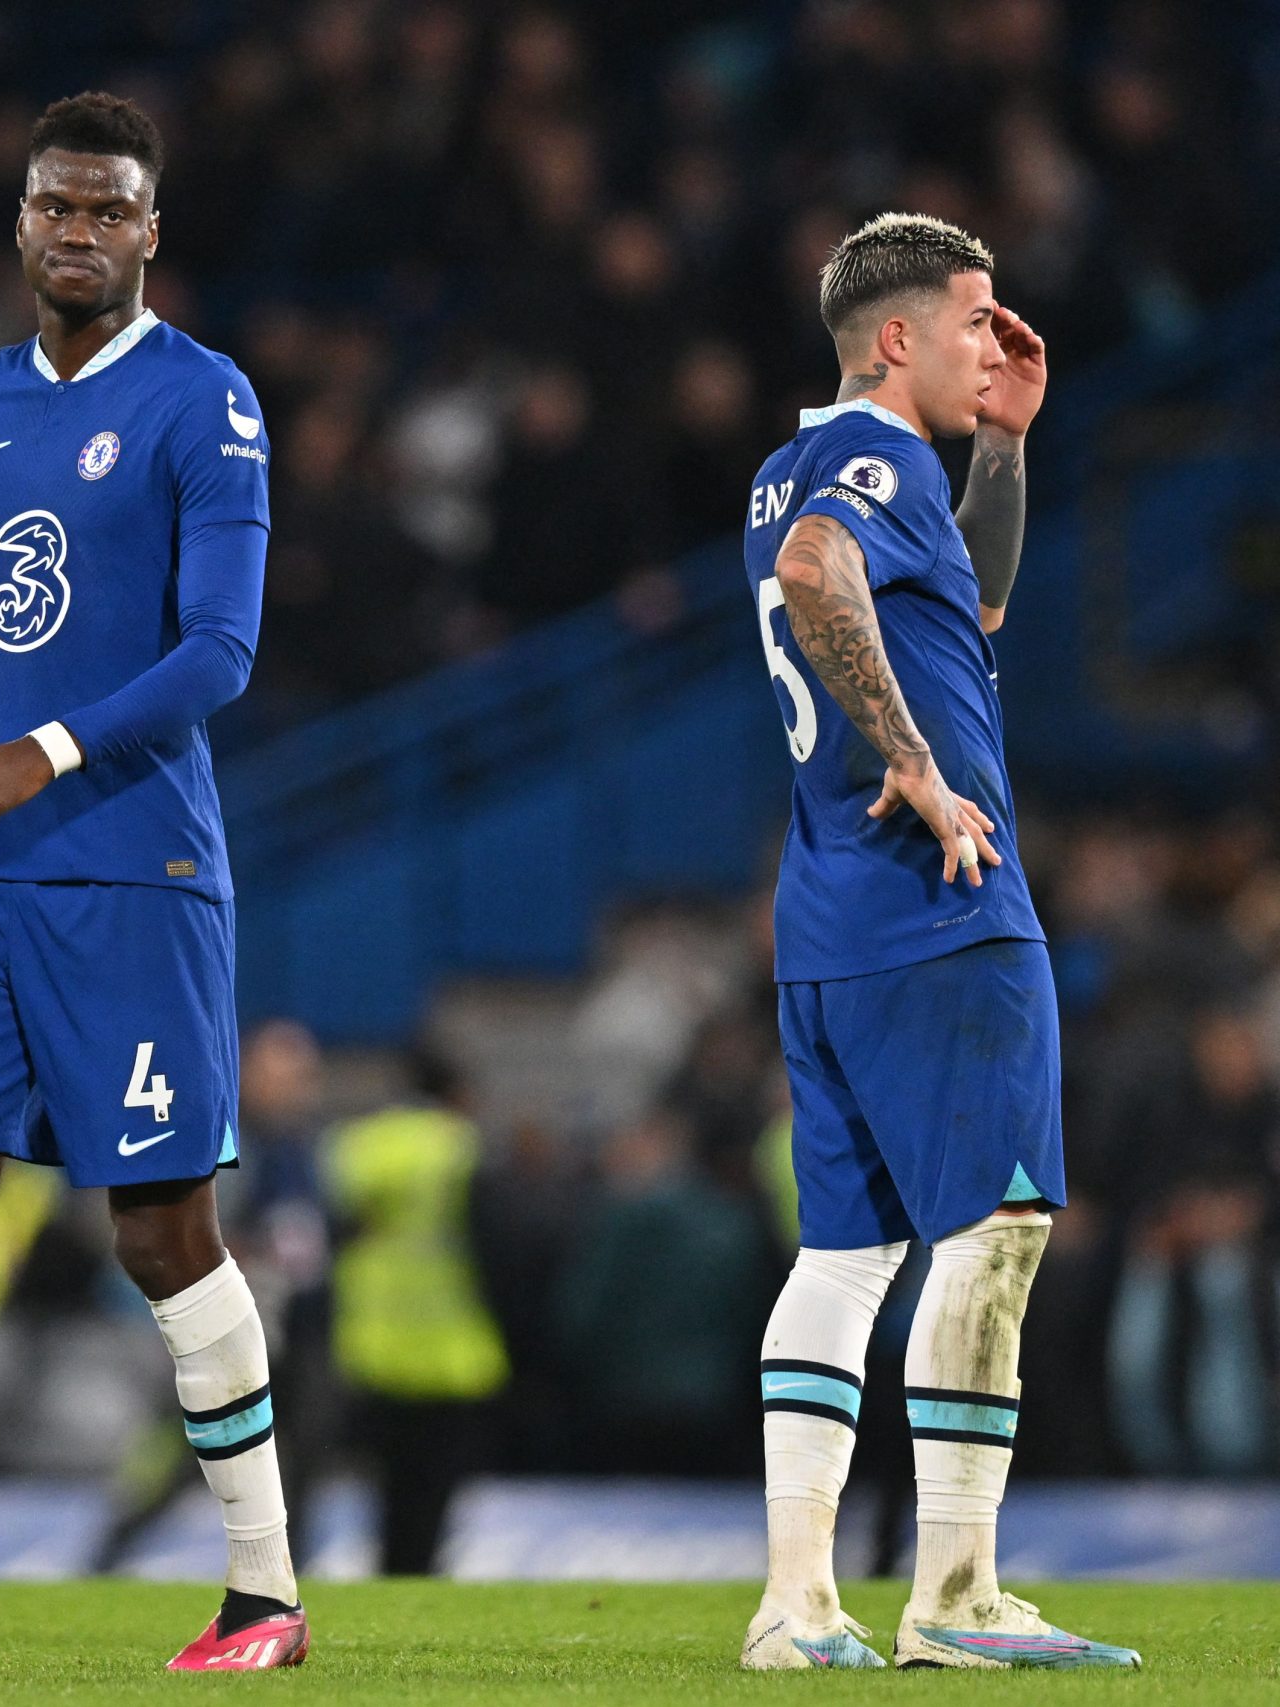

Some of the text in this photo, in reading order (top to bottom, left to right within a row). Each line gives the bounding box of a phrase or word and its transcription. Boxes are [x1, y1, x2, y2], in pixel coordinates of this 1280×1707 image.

[836, 487, 870, 511] room
[758, 575, 818, 764] 5
[123, 1041, 174, 1122] 4
